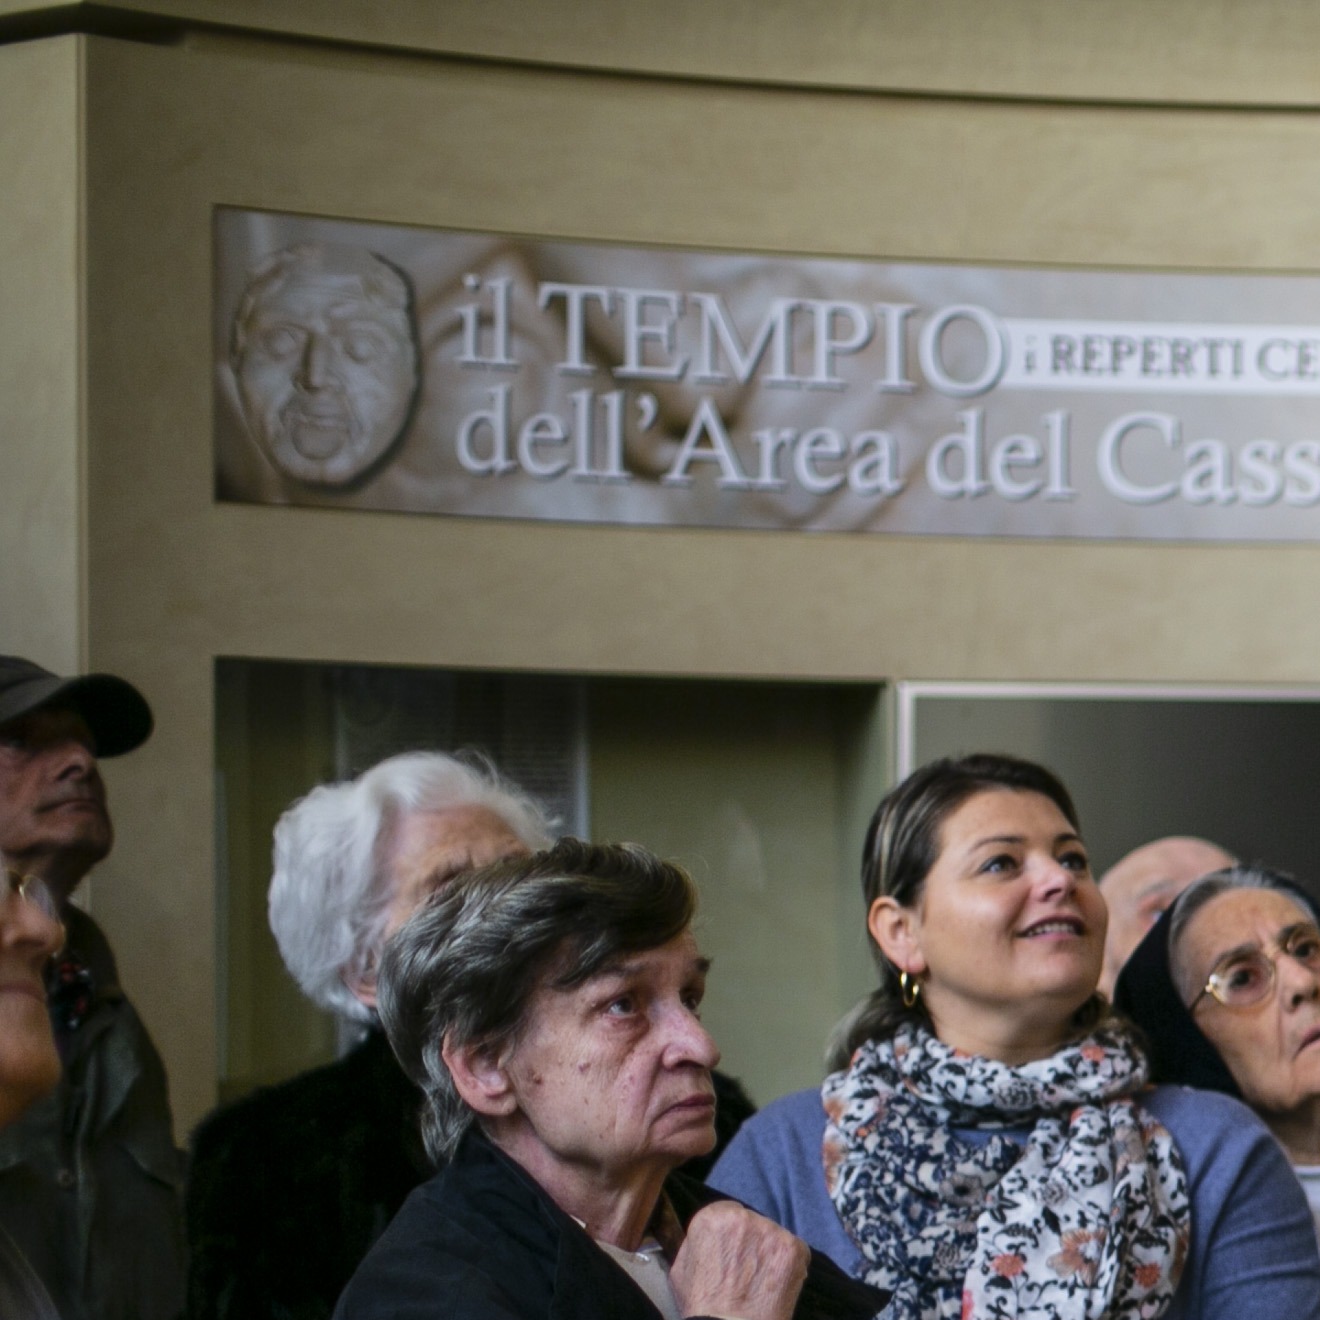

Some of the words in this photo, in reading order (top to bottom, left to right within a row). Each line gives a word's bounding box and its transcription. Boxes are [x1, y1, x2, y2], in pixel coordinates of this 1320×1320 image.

[457, 274, 517, 369] il
[541, 283, 1005, 396] TEMPIO
[1050, 334, 1245, 377] REPERTI
[926, 409, 1076, 502] del
